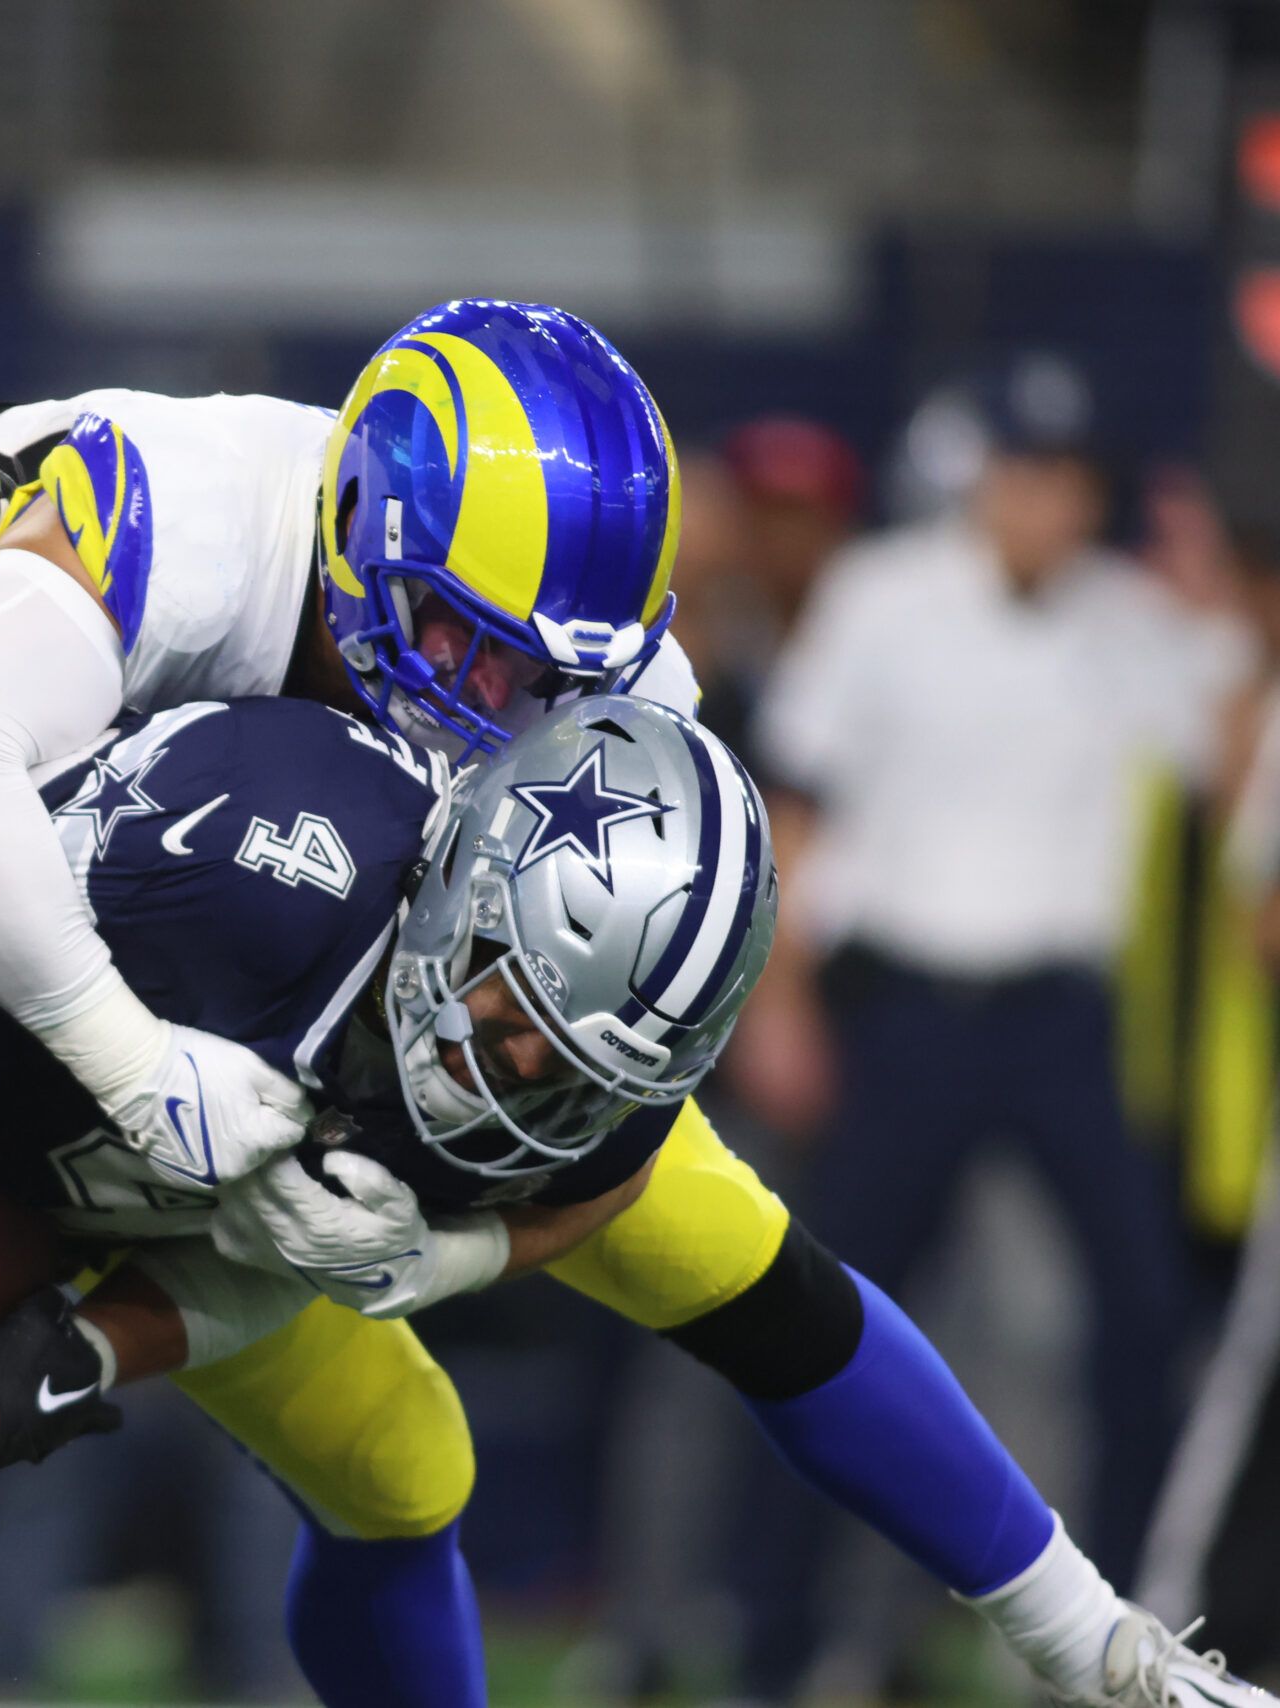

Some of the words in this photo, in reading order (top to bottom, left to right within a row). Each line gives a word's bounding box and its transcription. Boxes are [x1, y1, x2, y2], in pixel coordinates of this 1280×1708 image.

[234, 811, 357, 900] 4
[524, 953, 562, 1003] OAKLEY
[600, 1030, 660, 1067] COWBOYS
